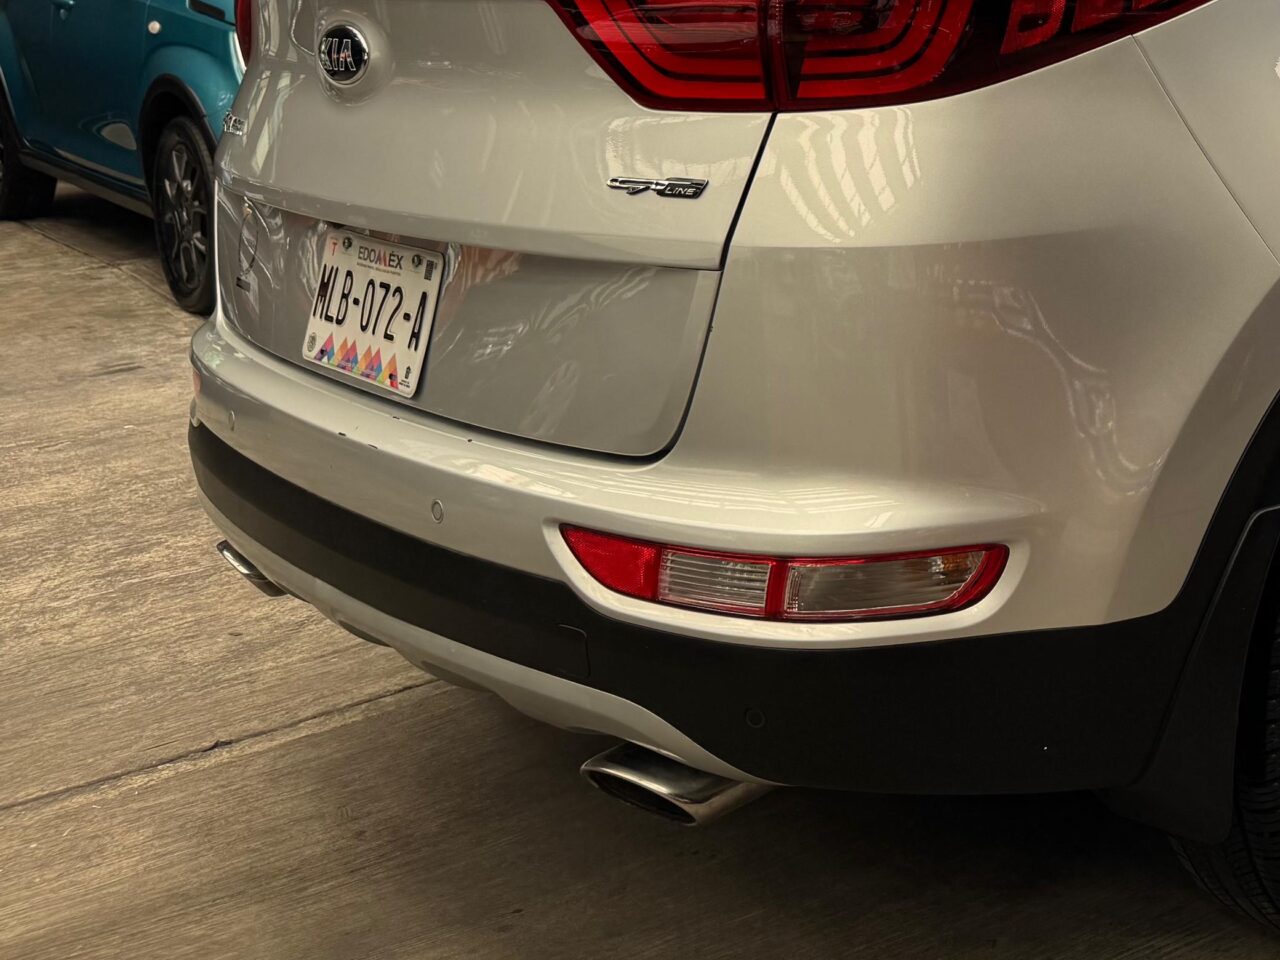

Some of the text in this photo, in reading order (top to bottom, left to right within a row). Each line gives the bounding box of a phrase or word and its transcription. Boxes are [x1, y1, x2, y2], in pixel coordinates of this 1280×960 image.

[321, 37, 357, 71] KIA
[357, 245, 404, 270] EDOMÉX
[312, 263, 428, 353] MLB-072-A
